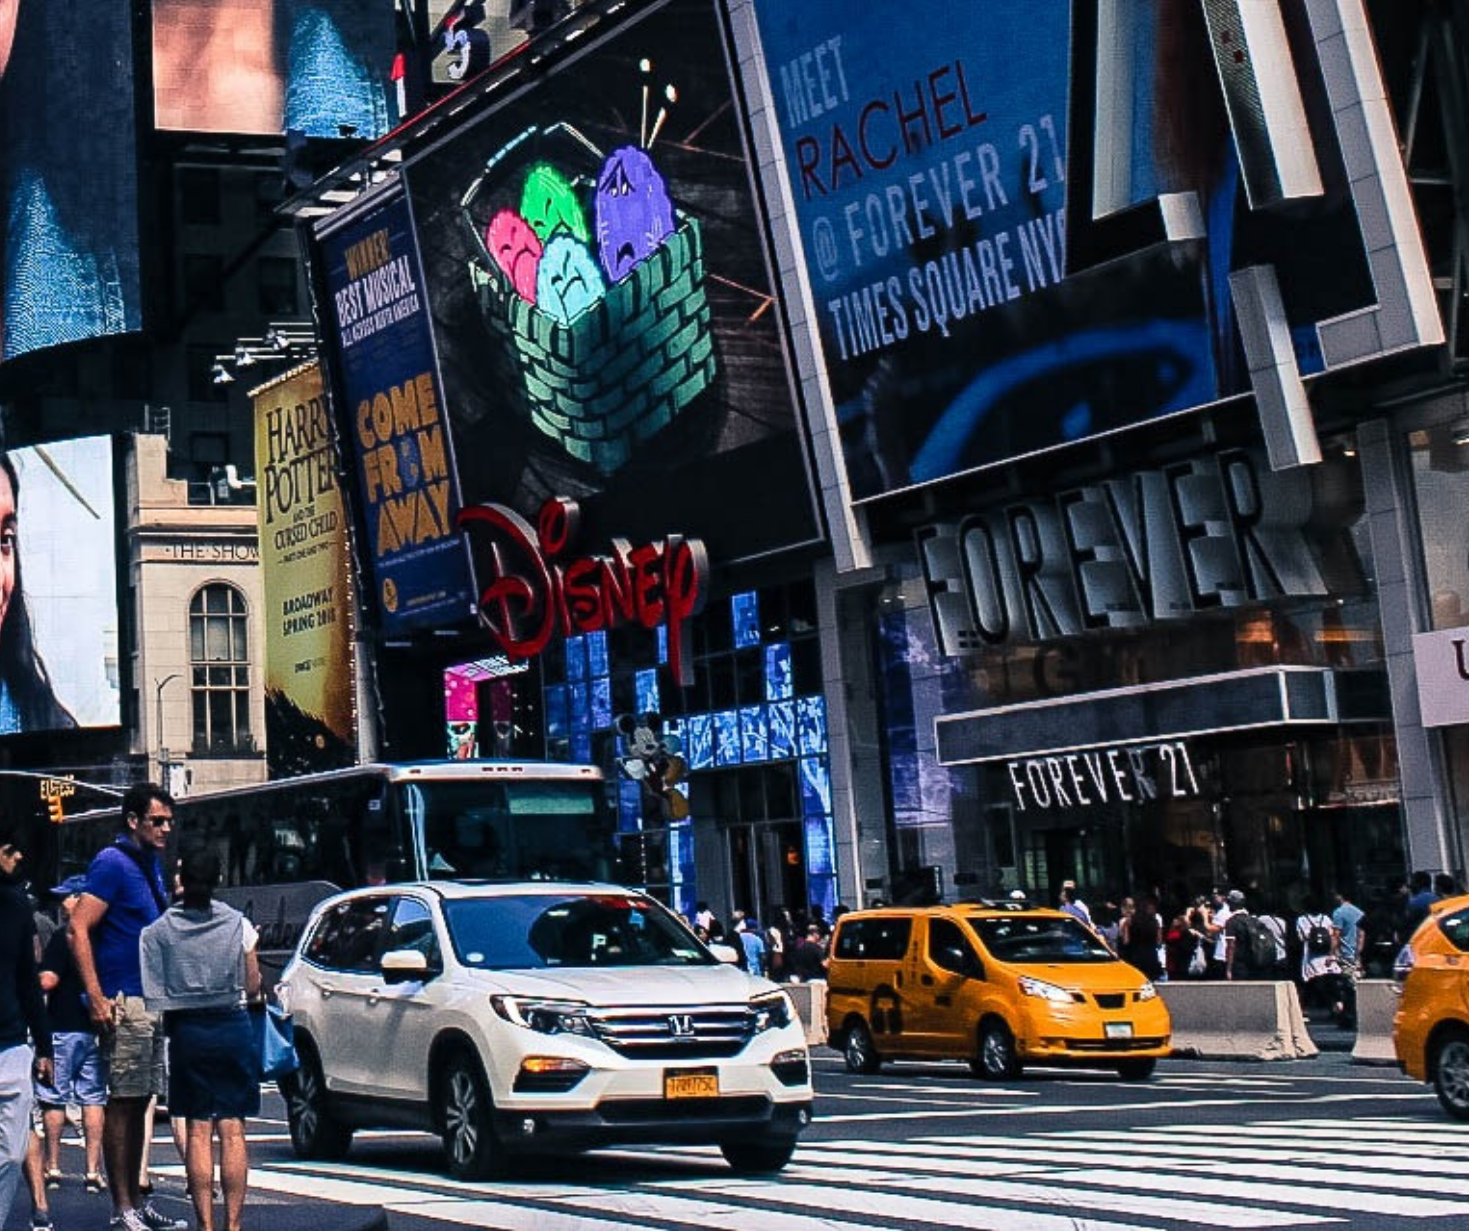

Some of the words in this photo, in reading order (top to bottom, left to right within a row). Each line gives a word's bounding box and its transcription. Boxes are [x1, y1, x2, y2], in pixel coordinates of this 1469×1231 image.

[780, 35, 850, 129] MEET
[796, 59, 988, 202] RACHEL
[843, 142, 1010, 267] FOREVER
[1017, 113, 1066, 195] 21
[335, 281, 364, 328] BEST
[362, 254, 416, 314] MUSICAL
[828, 274, 909, 361] TIMES
[909, 230, 1020, 338] SQUARE
[356, 372, 438, 451] COME
[360, 425, 450, 502] FROM
[172, 543, 205, 559] THE
[274, 522, 307, 551] CURSED
[307, 511, 339, 537] CHILD
[375, 483, 452, 558] AWAY
[912, 448, 1329, 657] FOREVER
[282, 586, 334, 616] BROADWAY
[282, 613, 316, 637] SPRING
[1007, 745, 1158, 812] FOREVER
[1158, 741, 1200, 797] 21
